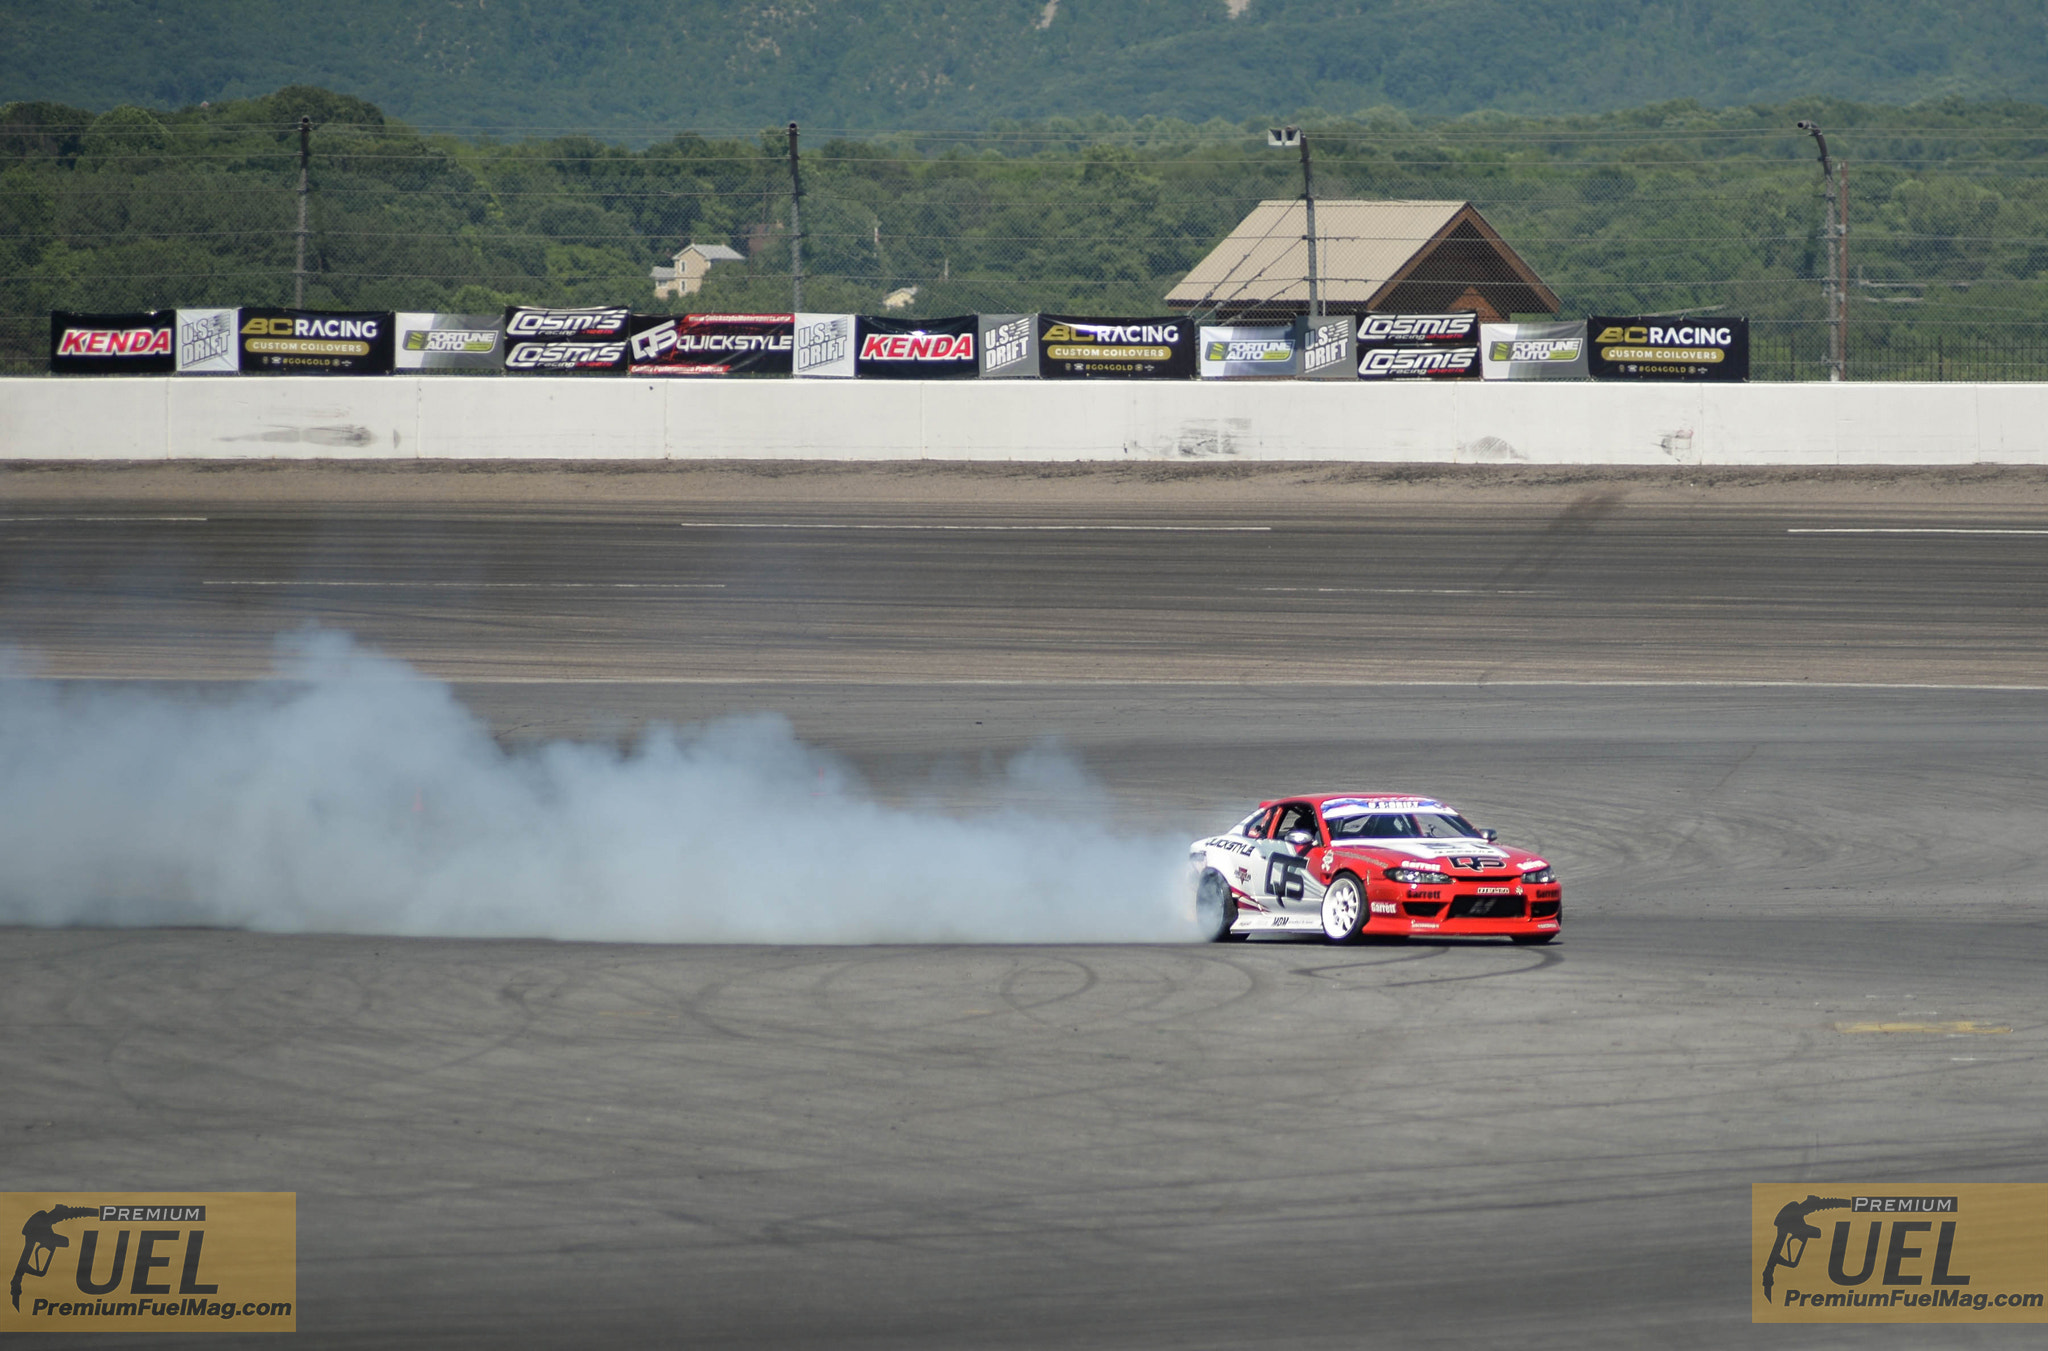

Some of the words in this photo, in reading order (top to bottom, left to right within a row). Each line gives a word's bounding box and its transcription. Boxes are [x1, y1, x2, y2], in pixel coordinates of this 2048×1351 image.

[295, 319, 377, 338] RACING
[799, 322, 830, 349] U.S.
[985, 324, 1013, 349] U.S.
[1097, 325, 1179, 342] RACING
[1650, 327, 1731, 345] RACING
[57, 328, 171, 355] KENDA
[427, 332, 495, 342] FORTUNE
[677, 335, 793, 351] QUICKSTYLE
[1305, 326, 1331, 350] U.S.
[182, 330, 230, 367] DRIFT
[253, 342, 297, 350] CUSTOM
[300, 343, 362, 352] COILOVERS
[425, 341, 464, 350] AUTO
[799, 337, 846, 370] DRIFT
[859, 333, 973, 360] KENDA
[986, 336, 1028, 369] DRIFT
[1055, 348, 1099, 356] CUSTOM
[1103, 348, 1164, 357] COILOVERS
[1228, 342, 1292, 351] FORTUNE
[1305, 338, 1348, 369] DRIFT
[1513, 341, 1579, 351] FORTUNE
[1226, 351, 1263, 360] AUTO
[1511, 351, 1550, 360] AUTO
[1609, 350, 1653, 358] CUSTOM
[1656, 351, 1717, 359] COILOVERS
[1407, 890, 1440, 899] Garrett
[1371, 901, 1397, 913] Garrett
